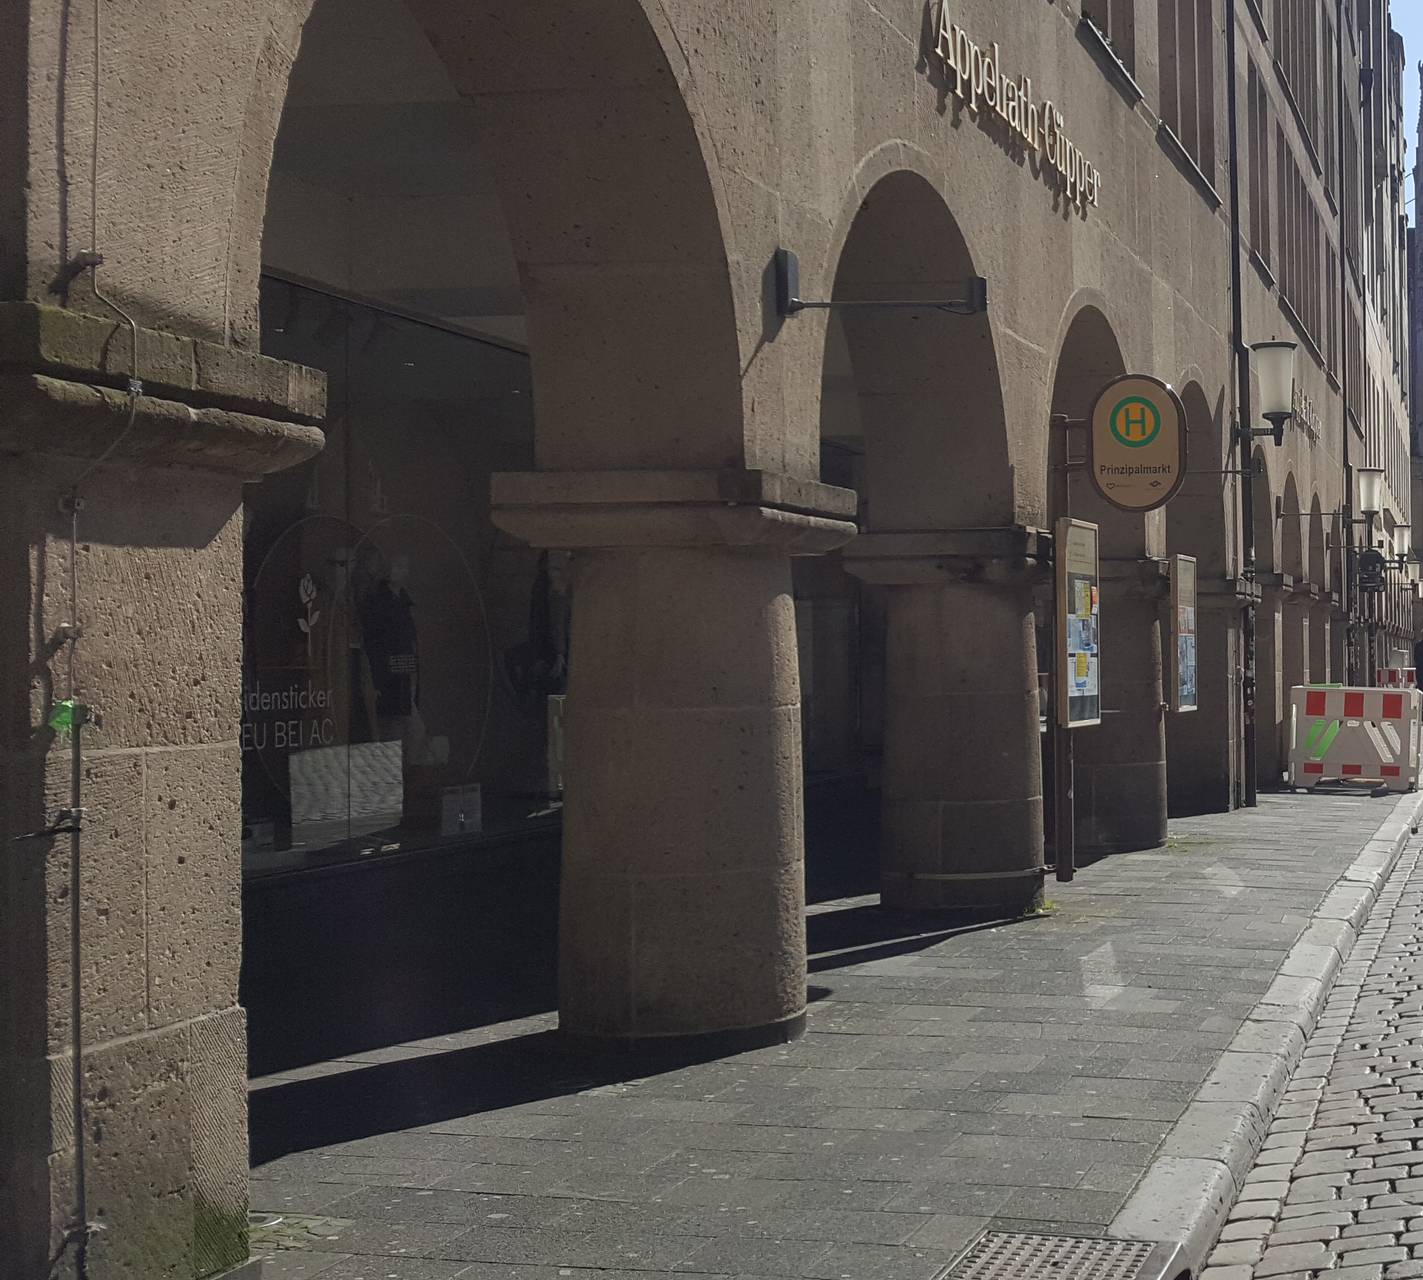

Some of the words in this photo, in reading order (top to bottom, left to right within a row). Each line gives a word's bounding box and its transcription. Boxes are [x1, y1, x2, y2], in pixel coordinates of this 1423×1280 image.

[935, 0, 1101, 208] Appelrath-Cüpper
[1124, 407, 1146, 436] H
[1100, 464, 1171, 476] Prinzipalmarkt
[275, 720, 303, 748] BEI
